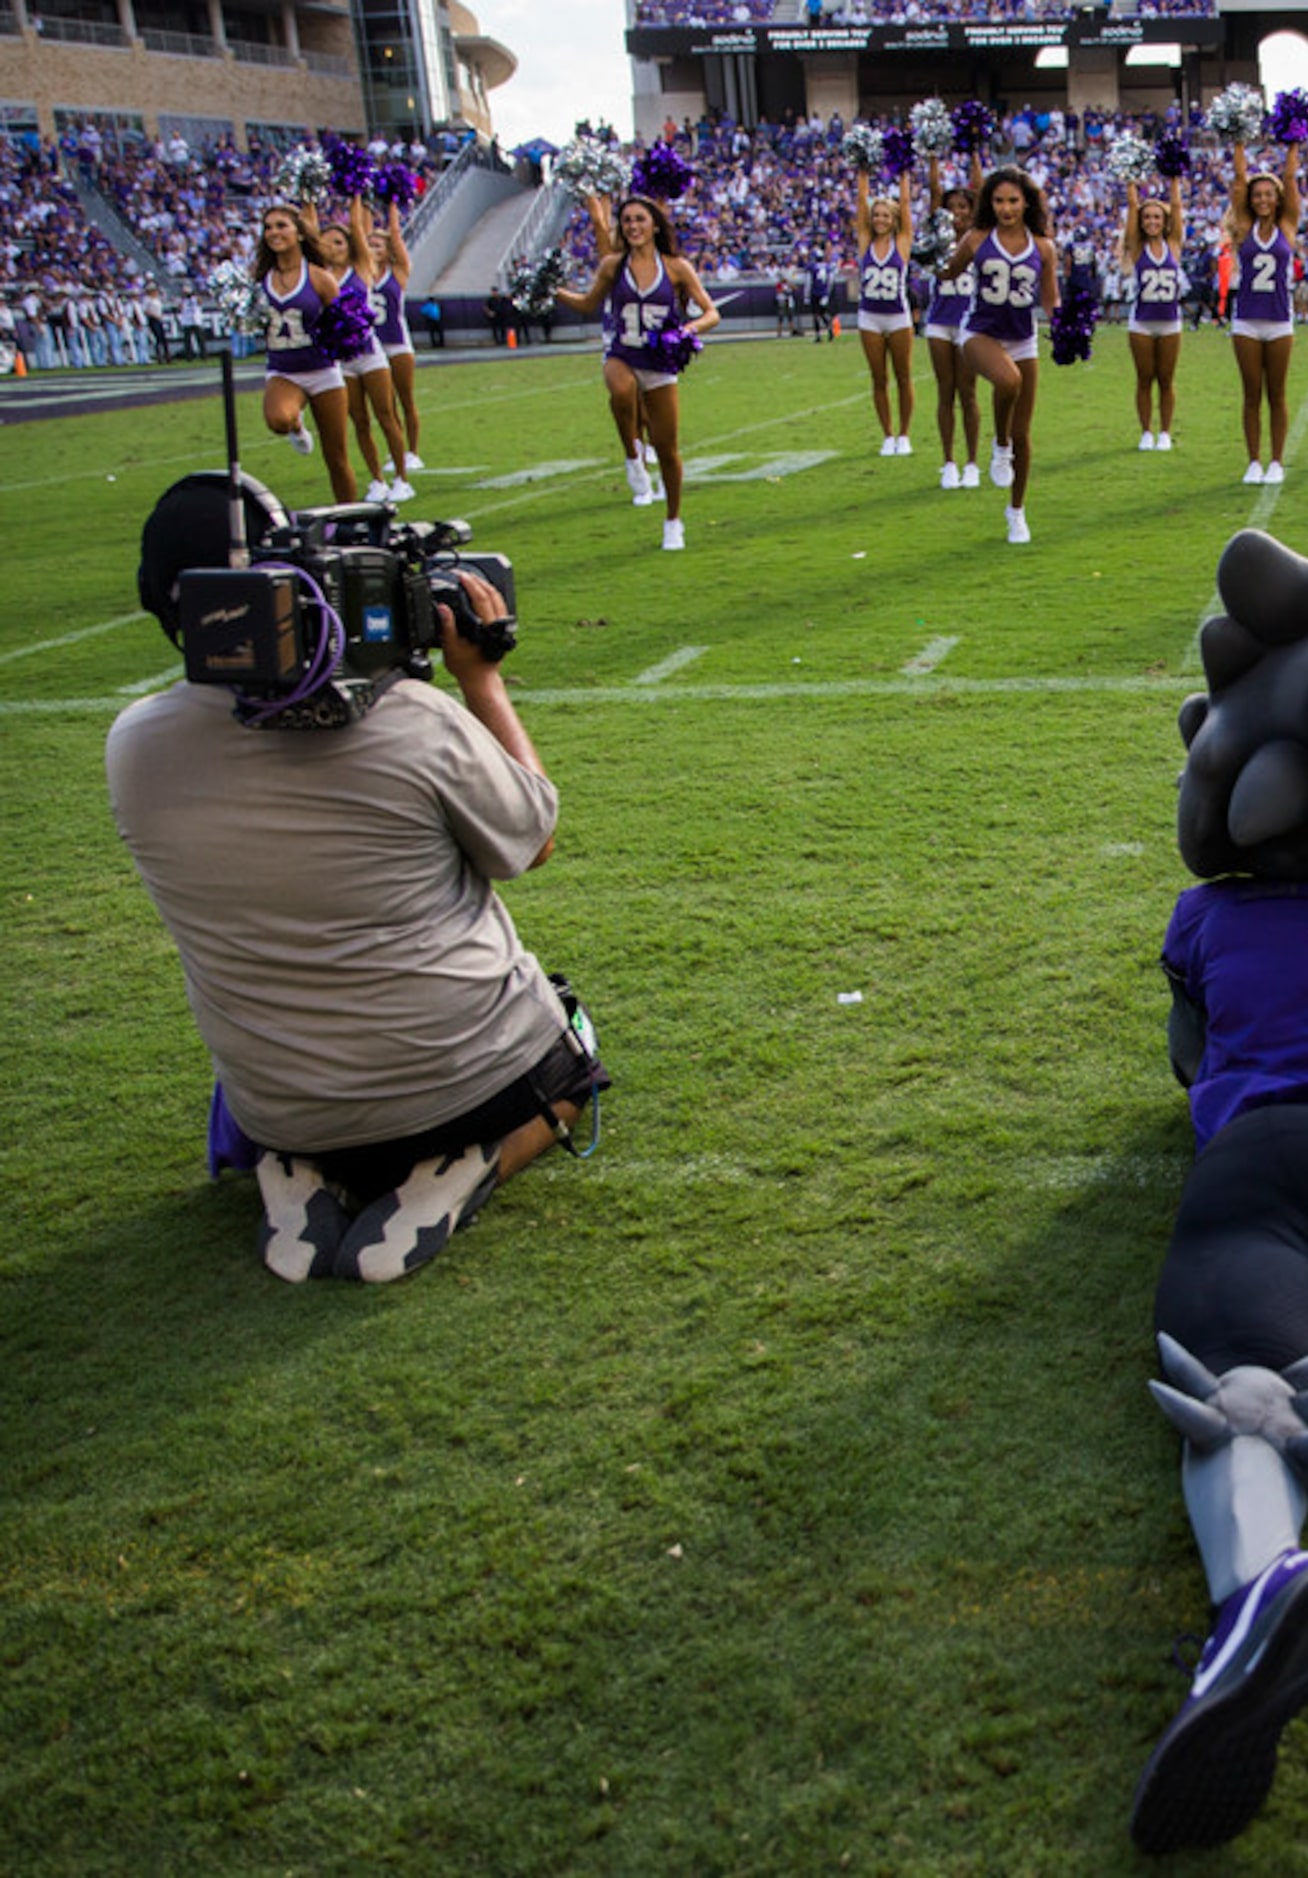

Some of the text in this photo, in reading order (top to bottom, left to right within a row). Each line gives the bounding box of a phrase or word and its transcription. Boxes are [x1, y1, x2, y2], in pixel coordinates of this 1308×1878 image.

[864, 266, 899, 301] 29
[981, 258, 1037, 308] 33
[1140, 268, 1178, 304] 25
[1251, 253, 1276, 293] 2
